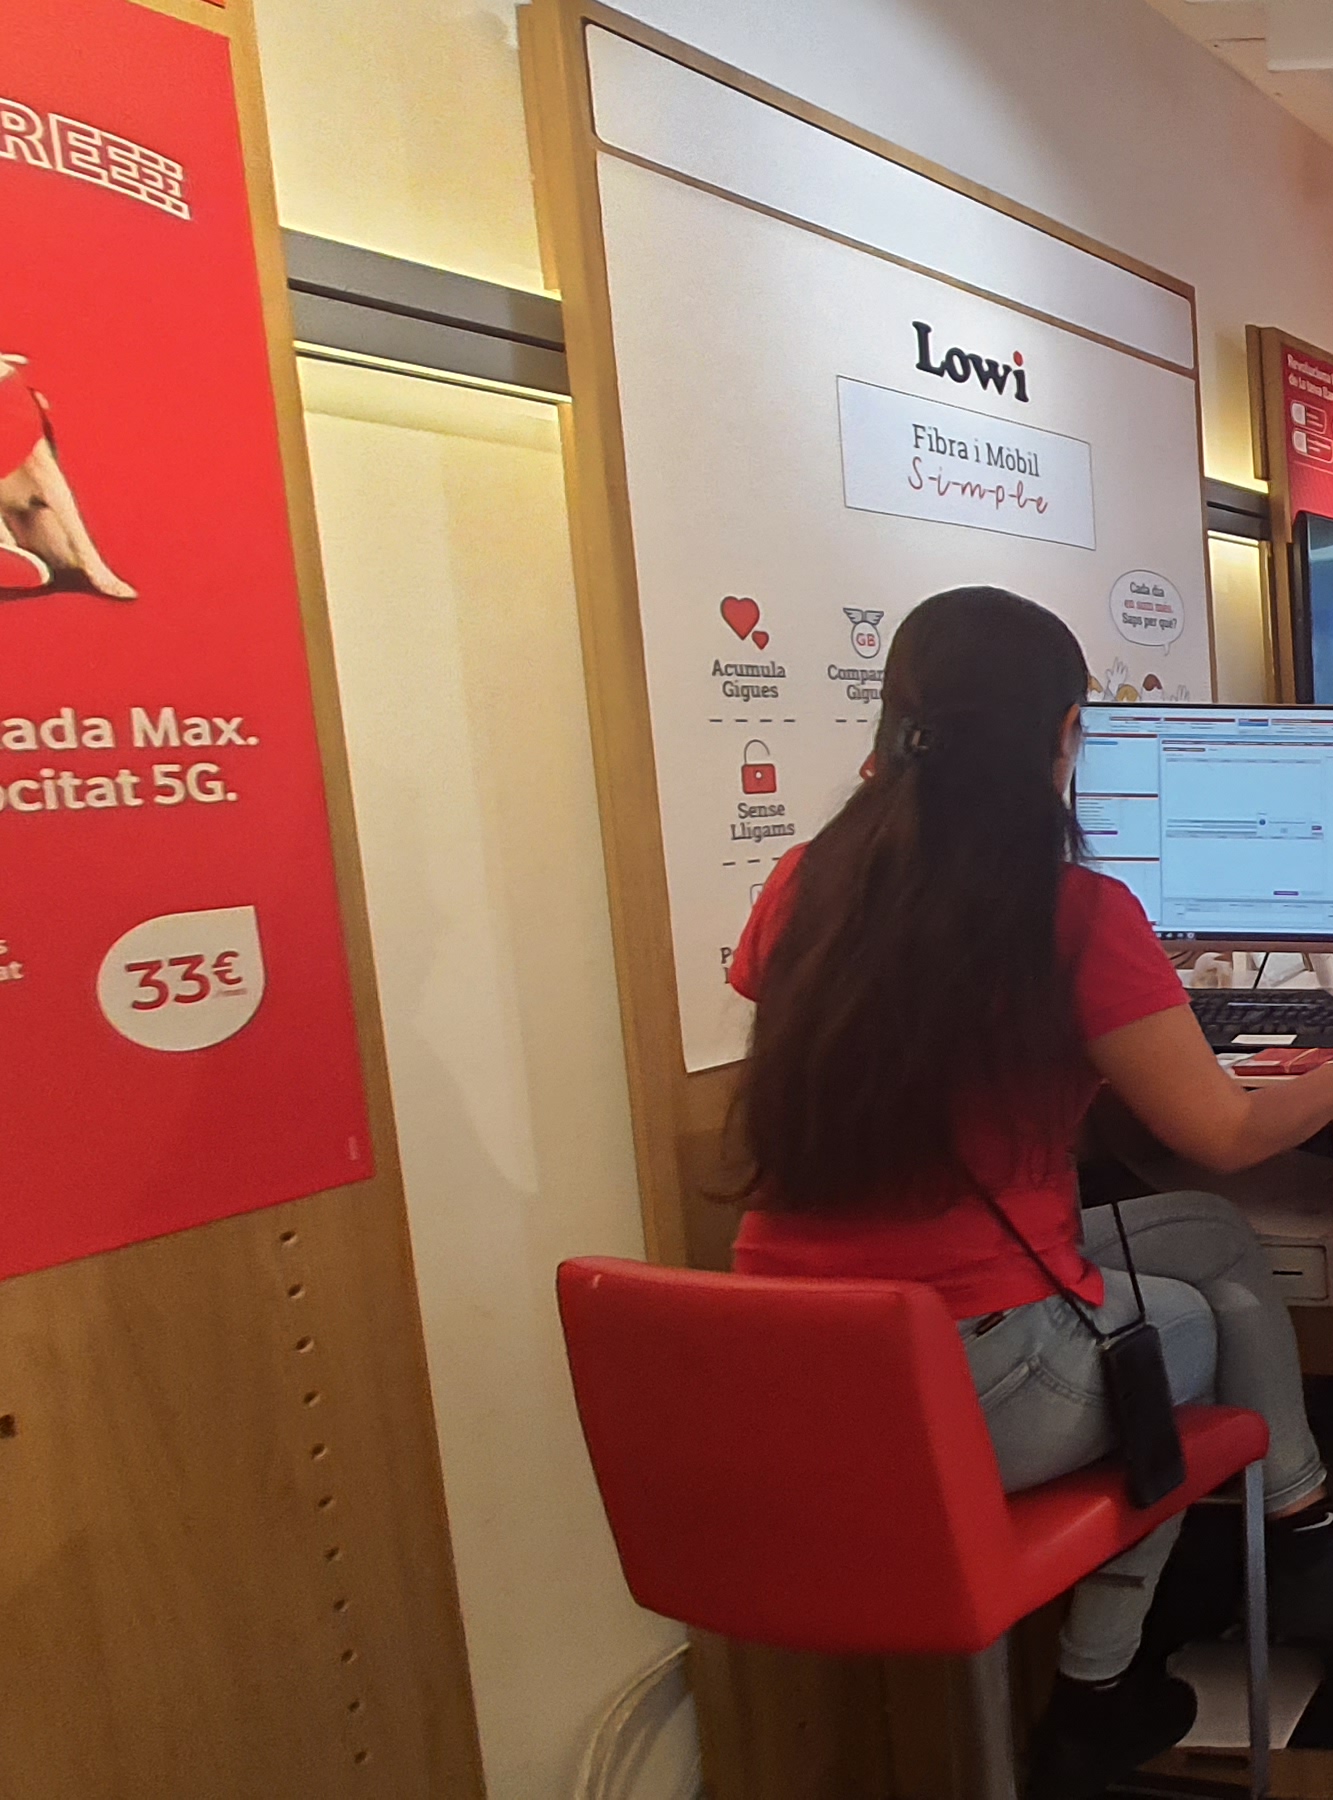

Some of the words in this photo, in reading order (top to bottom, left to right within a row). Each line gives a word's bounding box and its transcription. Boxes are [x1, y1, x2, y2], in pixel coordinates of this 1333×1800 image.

[912, 321, 1029, 403] Lowi
[912, 424, 968, 460] Fibra
[974, 439, 981, 463] i
[986, 442, 1041, 477] Mòbil
[856, 633, 876, 647] GB
[711, 659, 786, 679] Acumula
[722, 681, 779, 702] Gigues
[847, 684, 882, 704] Gigu
[0, 707, 116, 751] ada
[131, 707, 260, 748] Max.
[0, 768, 144, 812] citat
[152, 762, 239, 805] 5G.
[738, 803, 785, 820] Sense
[730, 822, 796, 843] Lligams
[124, 950, 243, 1011] 33€
